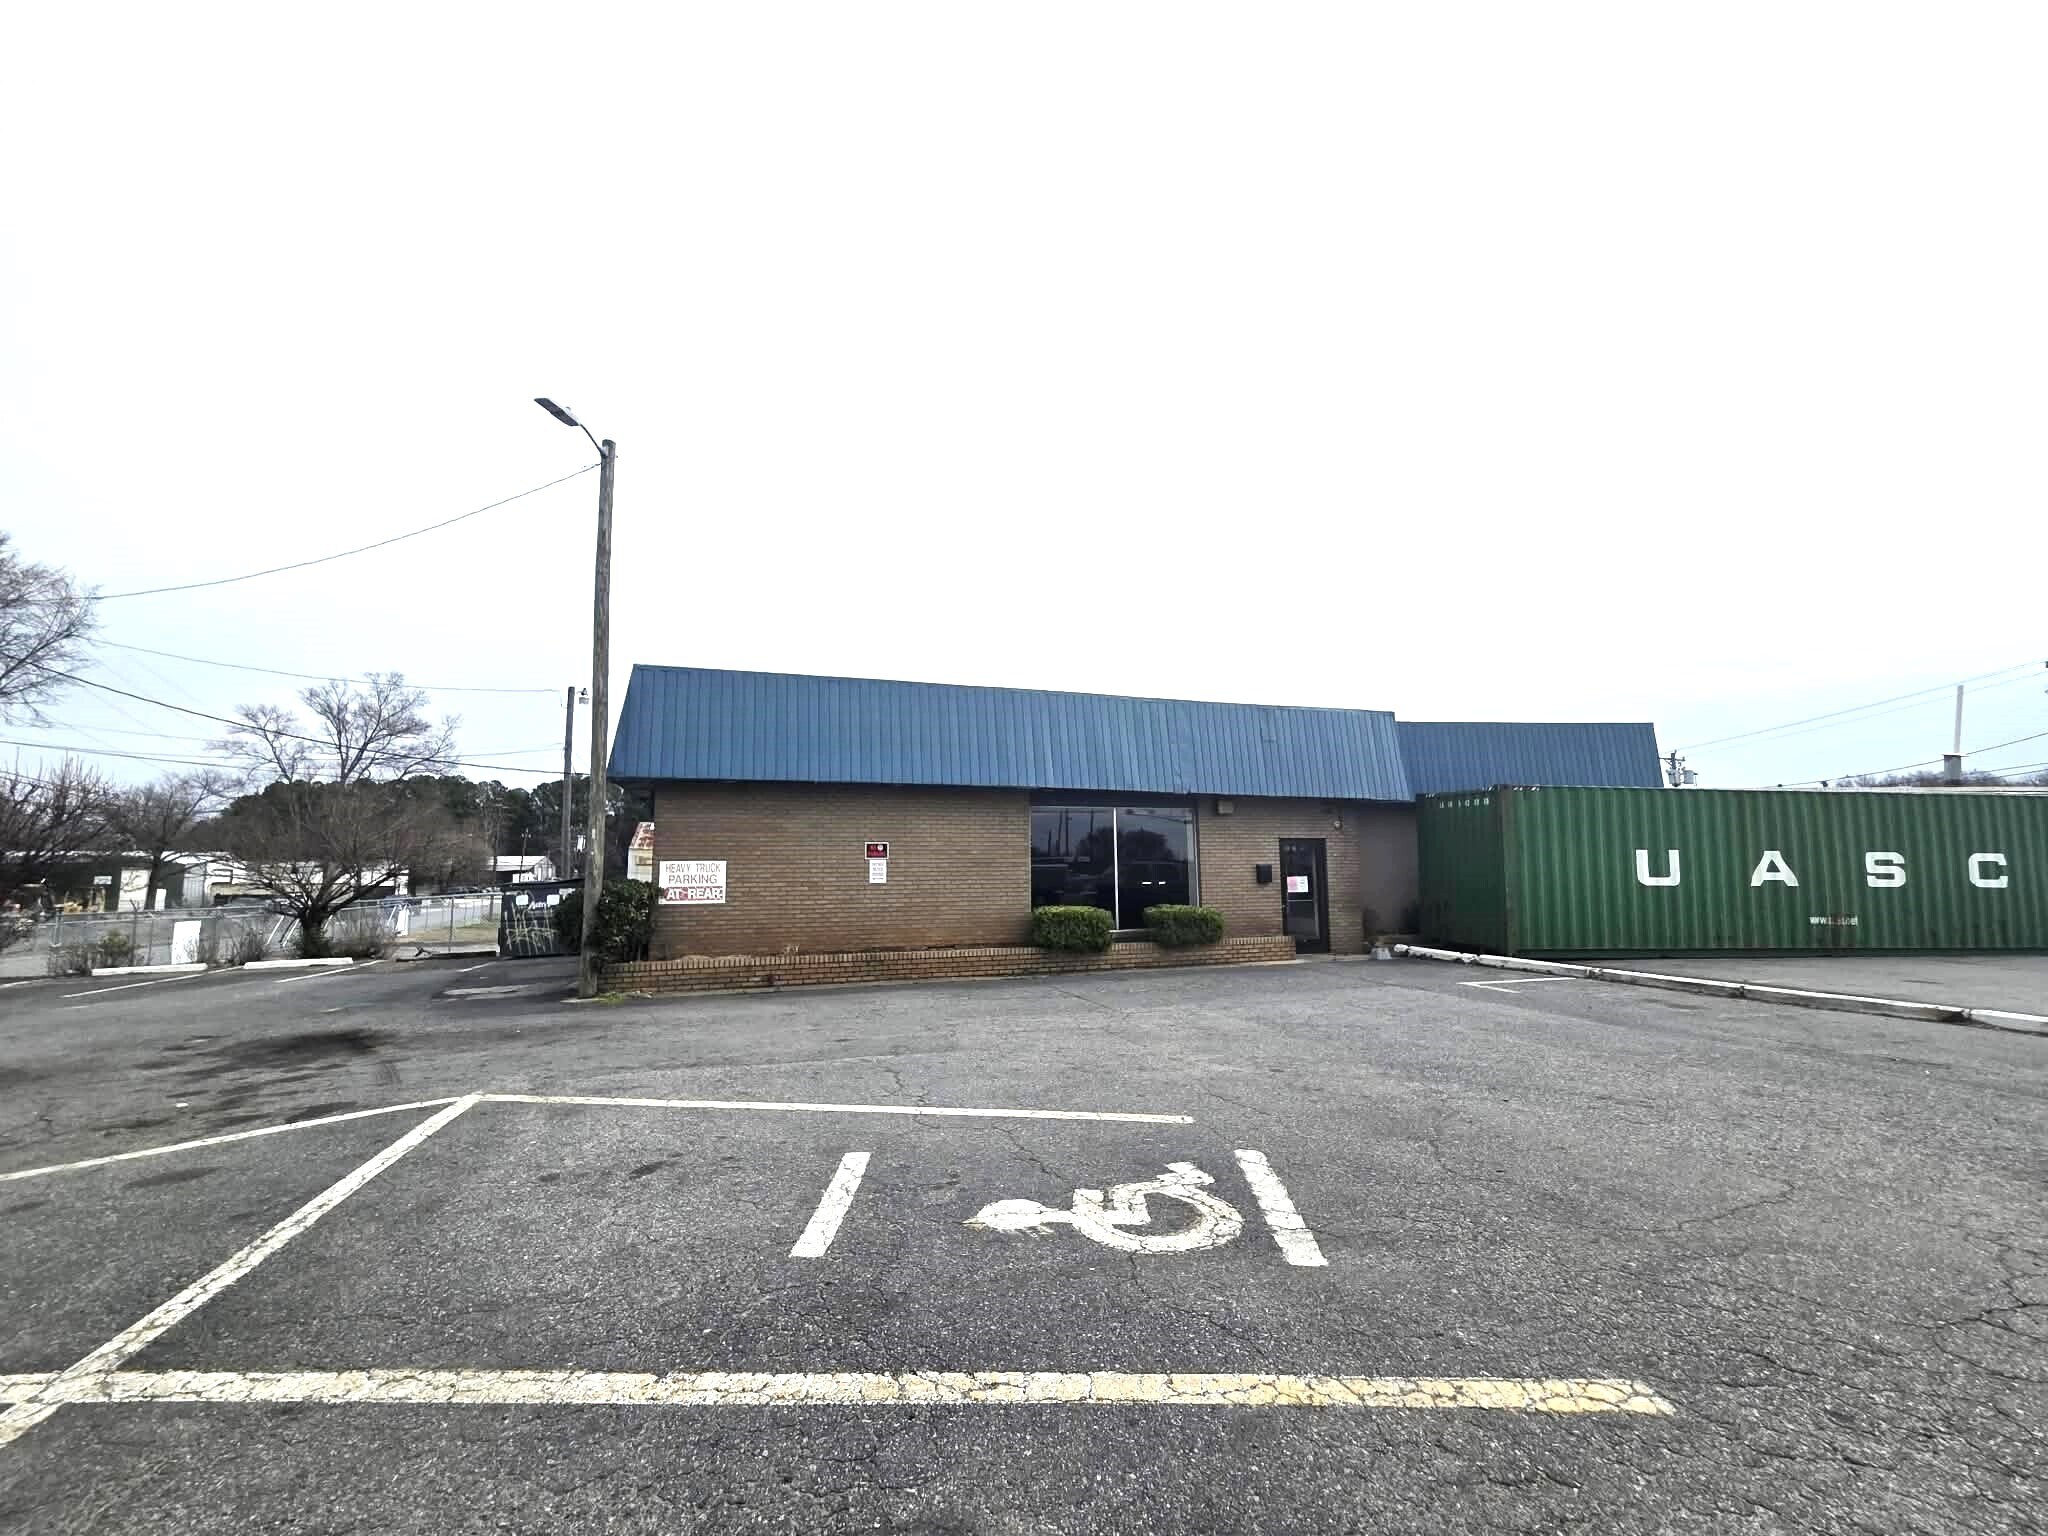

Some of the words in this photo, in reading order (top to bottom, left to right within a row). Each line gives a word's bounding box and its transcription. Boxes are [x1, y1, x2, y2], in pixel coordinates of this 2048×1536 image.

[665, 863, 691, 873] HEAVY
[696, 862, 721, 873] TRUCK
[668, 874, 717, 884] PARKING
[666, 888, 681, 900] AT
